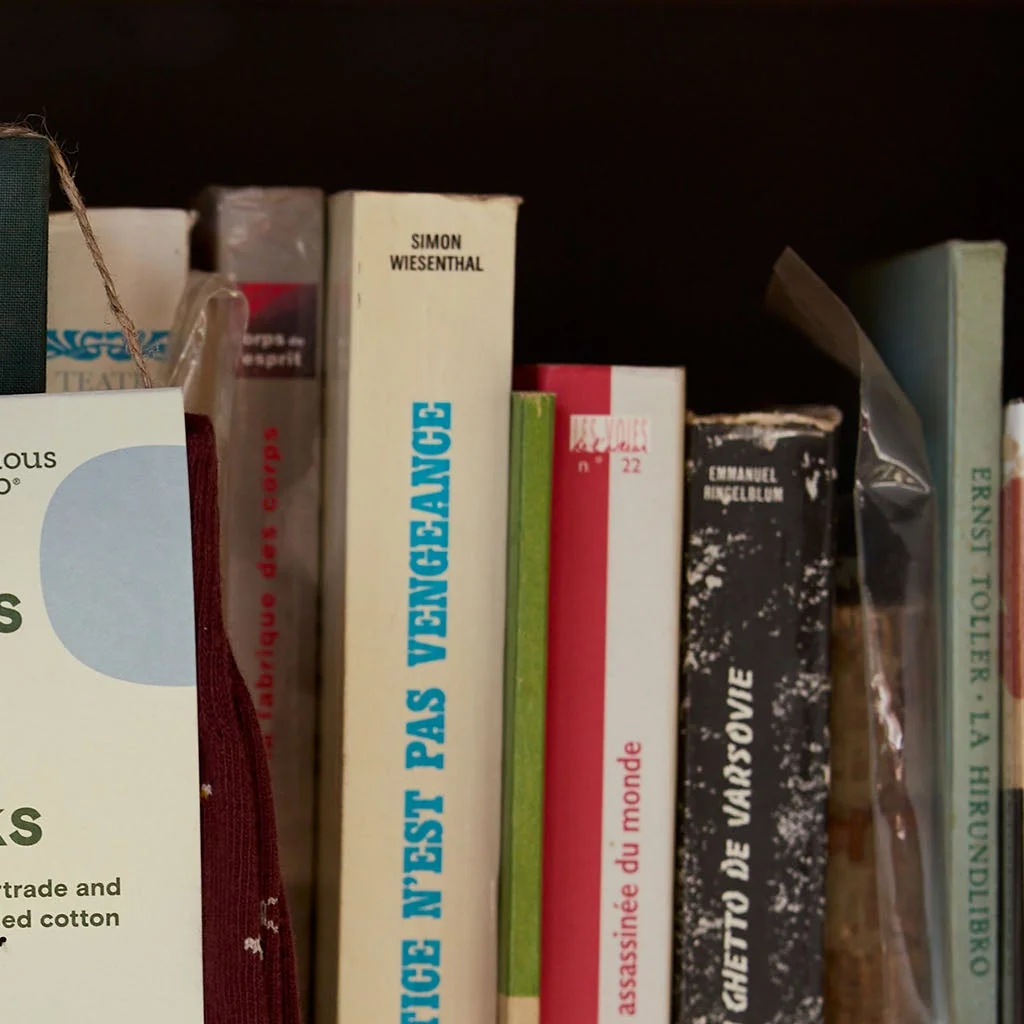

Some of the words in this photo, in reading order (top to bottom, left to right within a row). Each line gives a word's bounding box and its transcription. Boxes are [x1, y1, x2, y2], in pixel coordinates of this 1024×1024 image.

[389, 254, 484, 272] WIESENTHAL
[410, 233, 462, 250] SIMON
[260, 425, 284, 512] corps
[621, 457, 642, 474] 22
[255, 524, 279, 581] des
[406, 402, 452, 668] VENGEANCE
[970, 466, 993, 557] ERNST
[969, 575, 993, 684] TOLLER
[404, 687, 447, 770] PAS
[722, 666, 754, 828] VARSOVIE
[968, 711, 992, 749] LA
[616, 740, 643, 832] monde
[75, 877, 122, 897] and
[401, 789, 445, 919] N'EST
[615, 841, 640, 875] du
[720, 838, 751, 882] DE
[967, 765, 992, 978] HIRUNDLIBRO
[39, 908, 121, 928] cotton
[613, 883, 640, 1016] assassinée
[721, 894, 751, 1012] GHETTO
